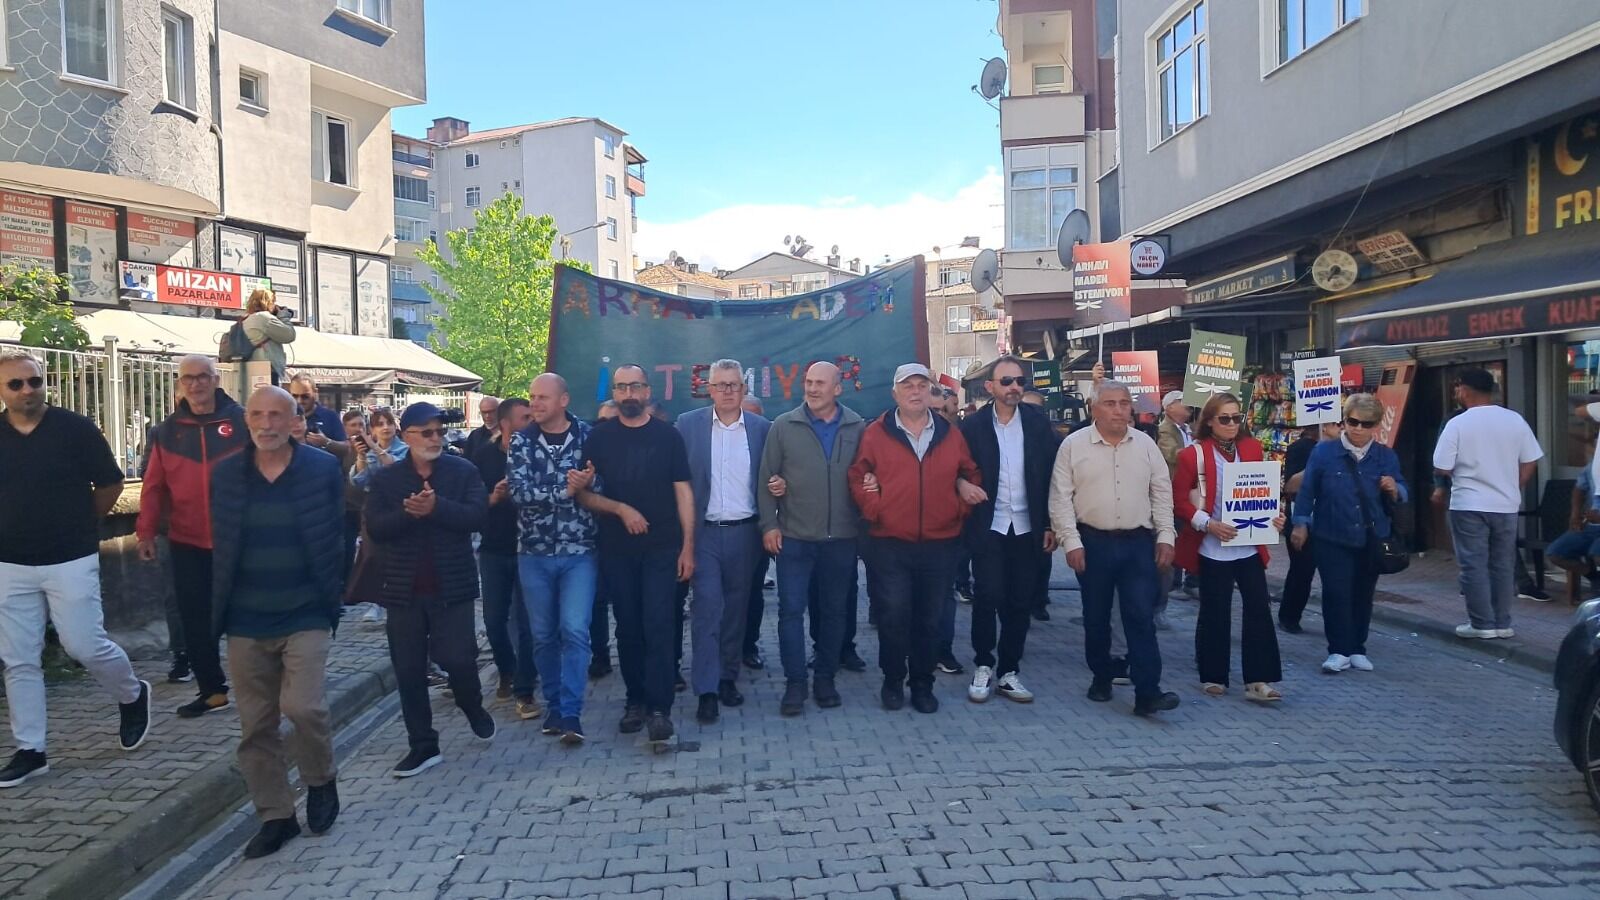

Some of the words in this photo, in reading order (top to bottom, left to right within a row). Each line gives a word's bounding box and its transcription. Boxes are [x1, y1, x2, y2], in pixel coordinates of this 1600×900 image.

[166, 269, 233, 293] MİZAN
[1075, 274, 1108, 287] MADEN
[1217, 277, 1254, 298] MARKET
[168, 287, 232, 302] PAZARLAMA
[785, 276, 895, 320] ADEN
[1386, 315, 1449, 341] AYYILDIZ
[1468, 305, 1525, 337] ERKEK
[1196, 353, 1235, 369] MADEN
[597, 356, 863, 402] İTEİYR
[1303, 378, 1333, 389] MADEN
[1232, 487, 1271, 499] MADEN
